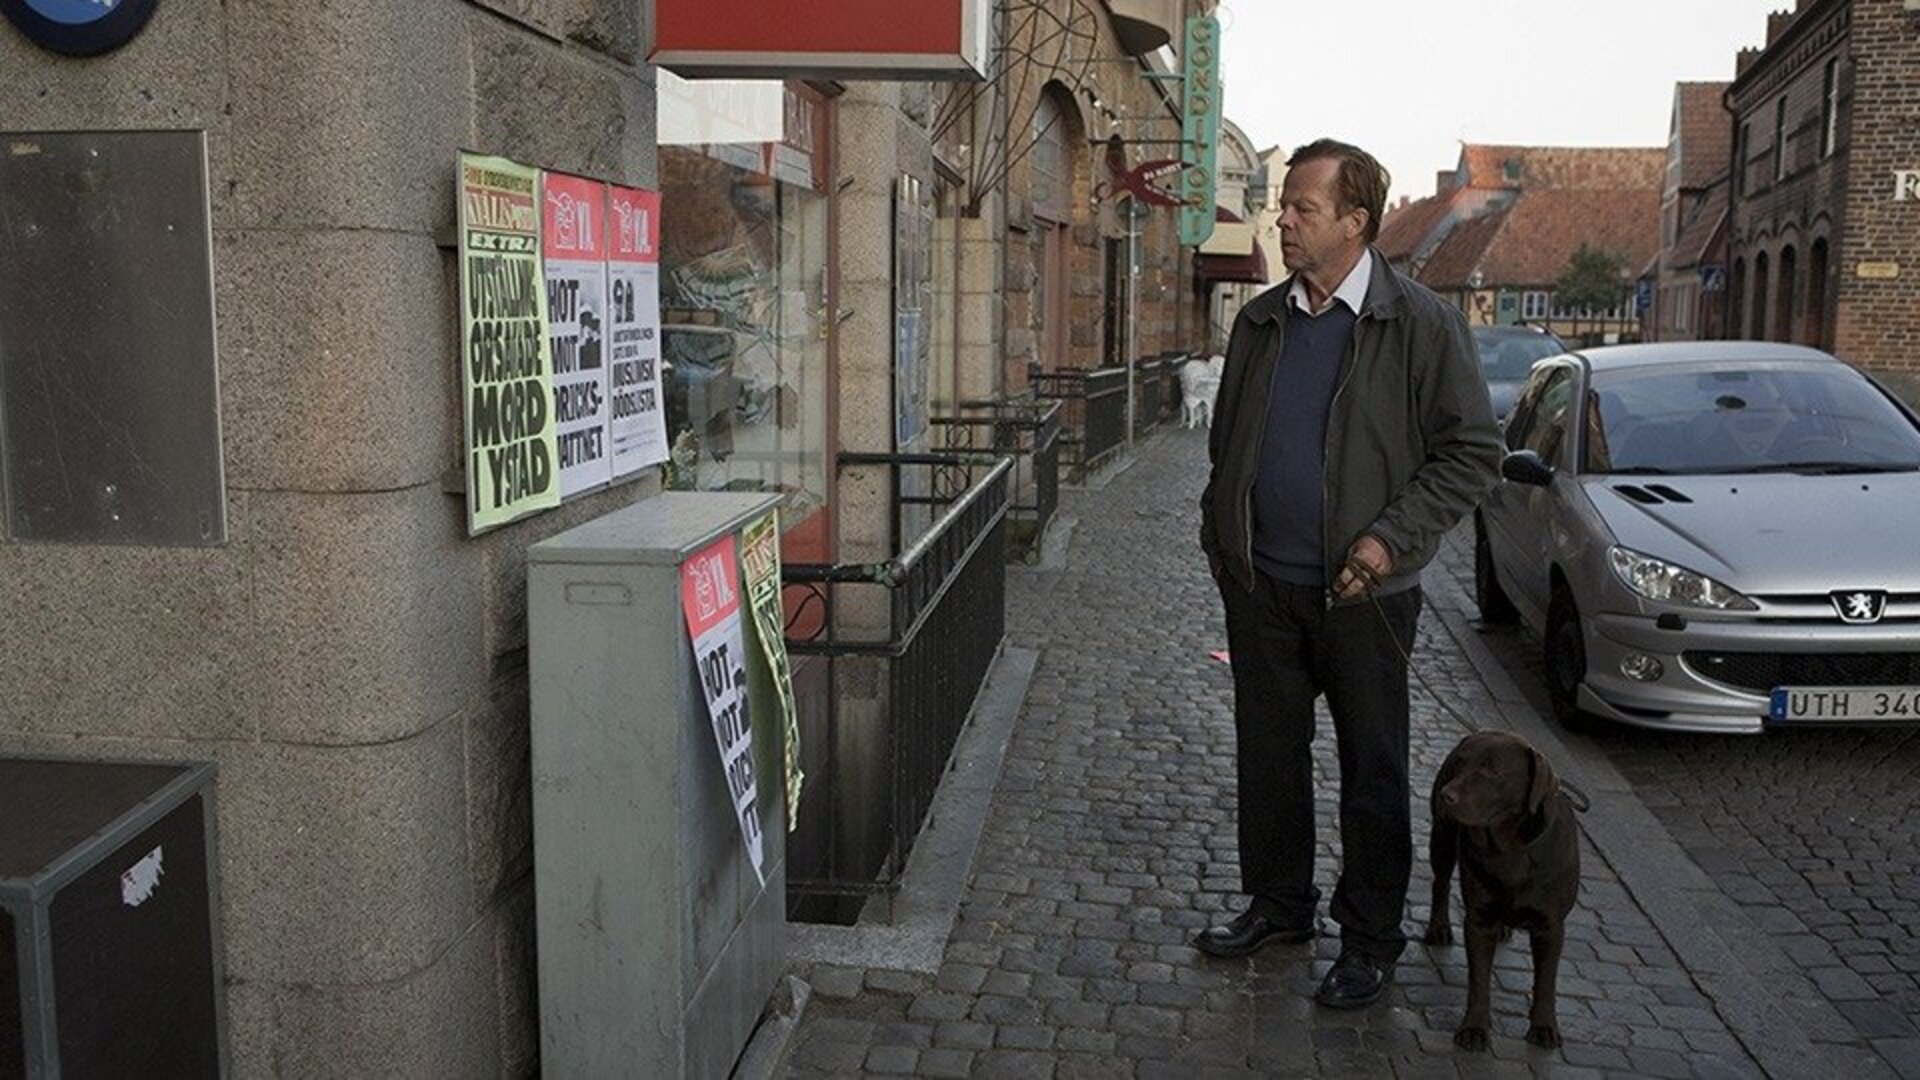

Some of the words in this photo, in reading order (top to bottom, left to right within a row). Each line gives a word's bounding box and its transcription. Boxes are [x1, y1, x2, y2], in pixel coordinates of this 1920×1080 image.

[470, 233, 535, 251] EXTRA
[547, 279, 579, 323] HOT
[470, 320, 542, 385] ORSAKADE
[472, 379, 546, 449] MORD
[473, 451, 480, 513] I
[487, 438, 551, 509] YSTAD
[1791, 693, 1849, 717] UTH
